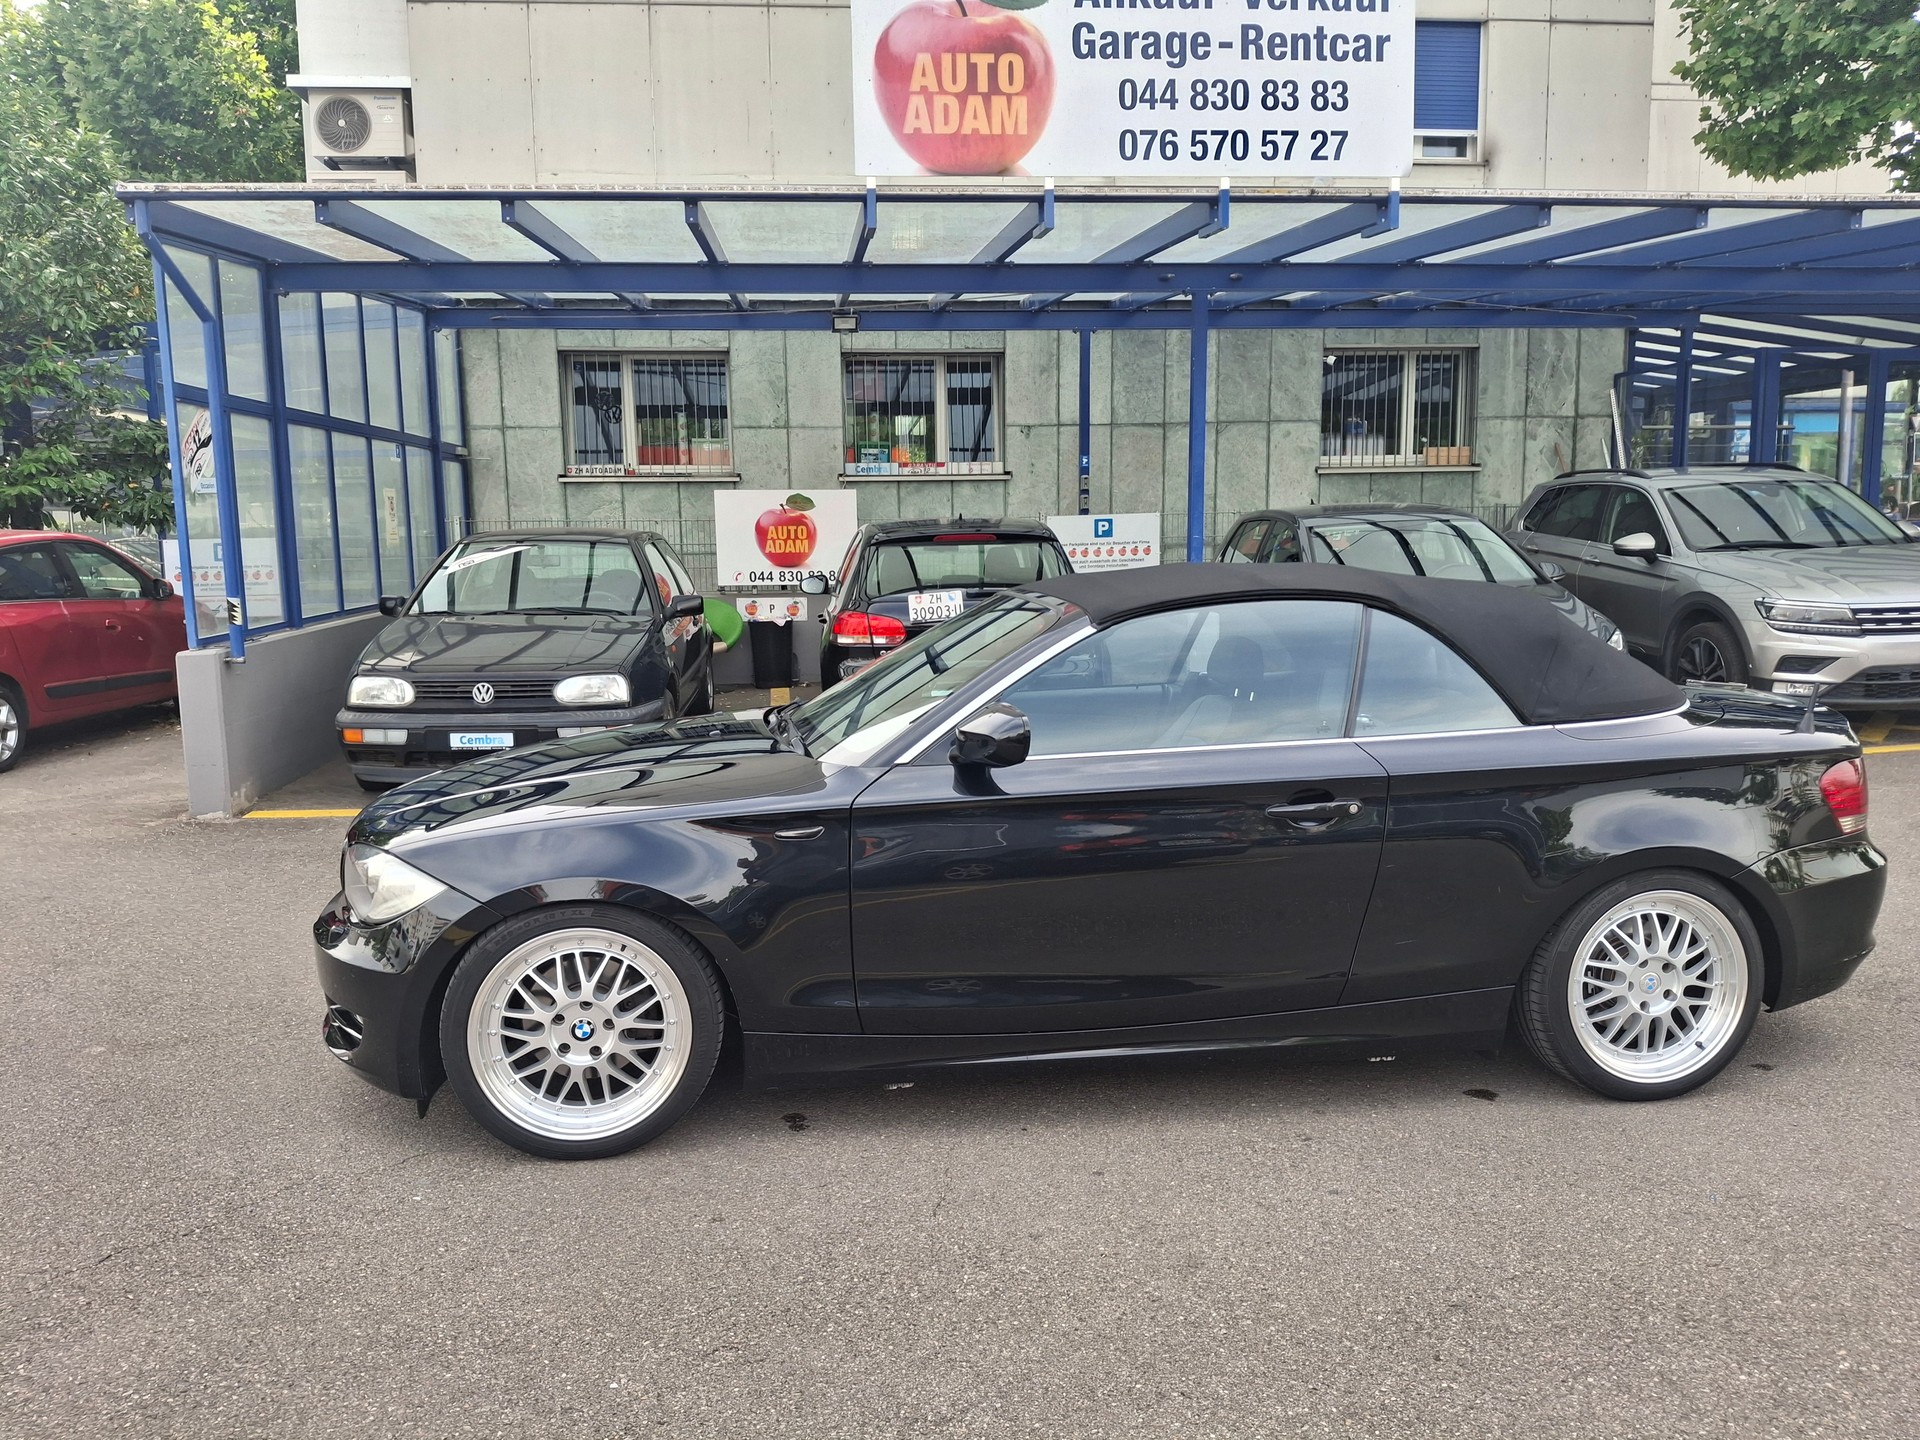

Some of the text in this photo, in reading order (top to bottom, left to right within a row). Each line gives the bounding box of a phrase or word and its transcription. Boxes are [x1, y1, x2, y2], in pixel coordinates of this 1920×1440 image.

[909, 52, 1025, 93] AUTO
[1119, 79, 1349, 112] 044 830 83 83
[903, 95, 1029, 136] ADAM
[1118, 129, 1349, 162] 076 570 57 27
[854, 465, 888, 474] Cembra
[767, 525, 808, 540] AUTO
[1098, 521, 1109, 535] P
[765, 539, 809, 553] ADAM
[749, 571, 774, 582] 044
[778, 571, 803, 582] 830
[928, 594, 943, 604] ZH
[769, 604, 776, 613] P
[459, 734, 505, 745] Cembra
